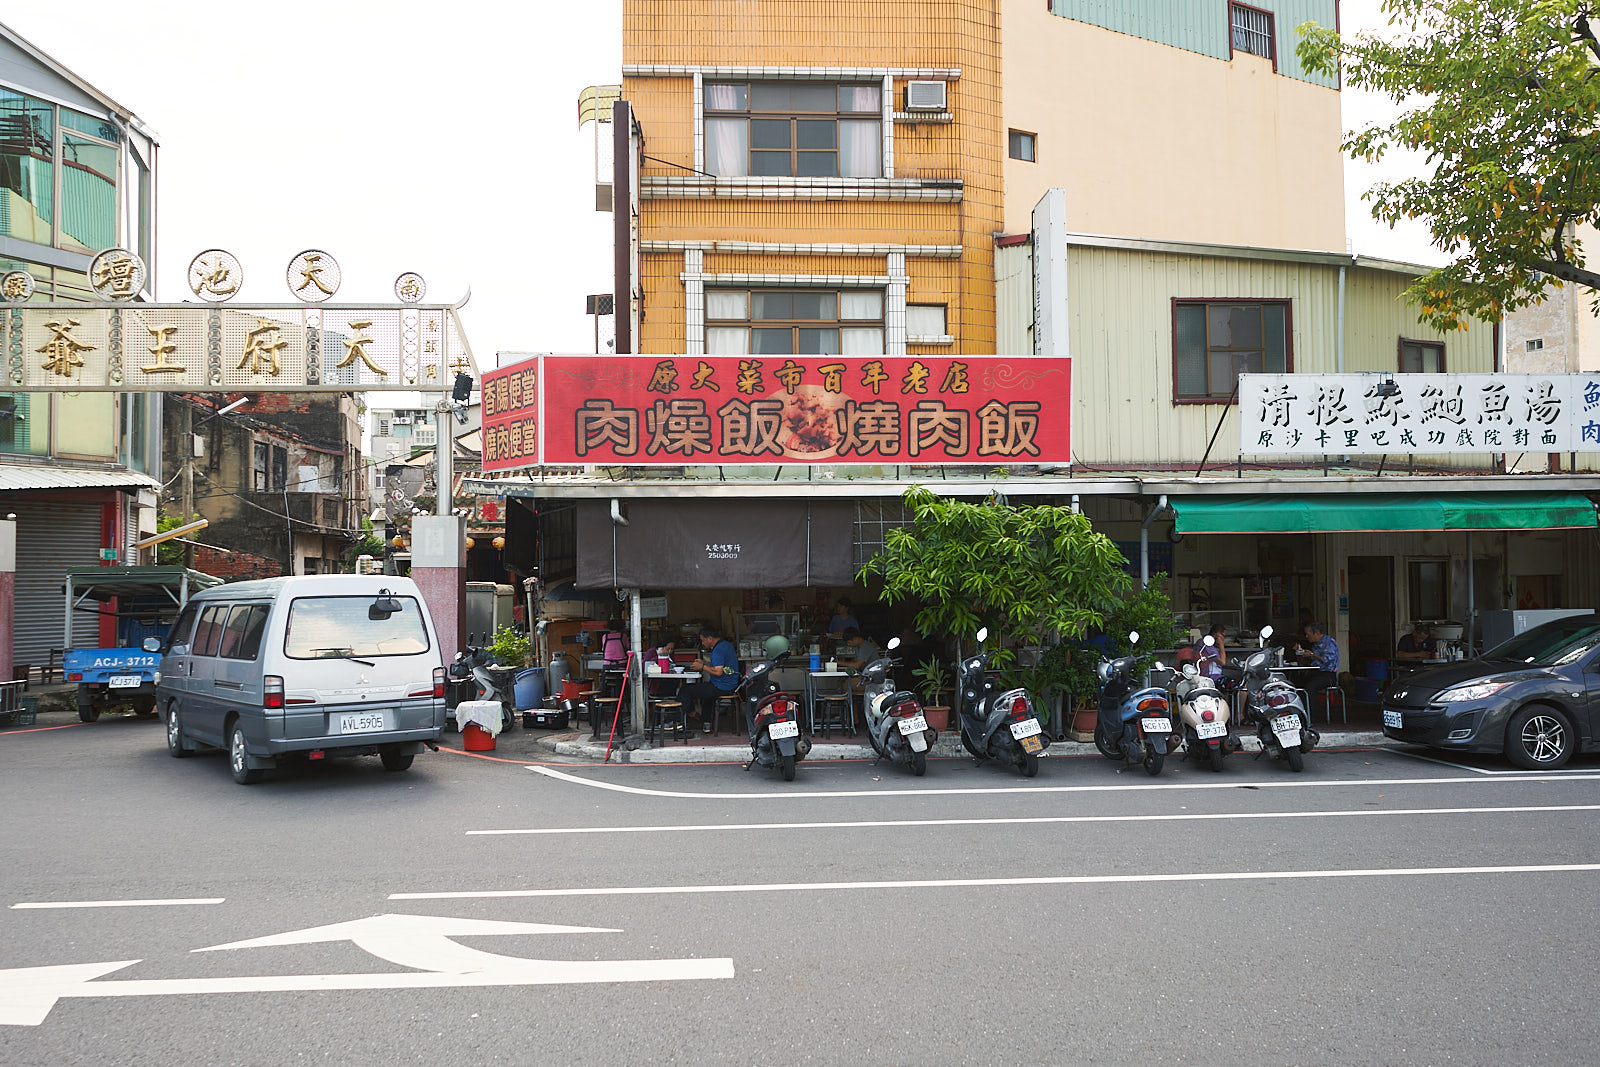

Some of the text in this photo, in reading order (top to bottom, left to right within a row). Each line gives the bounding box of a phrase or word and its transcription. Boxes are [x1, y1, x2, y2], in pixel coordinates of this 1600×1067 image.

[484, 367, 535, 416] 香腸便當
[646, 358, 971, 395] 原大菜市百年老店
[484, 417, 536, 462] 燒肉便當
[574, 398, 1042, 457] 肉燥飯 燒肉飯
[1257, 427, 1557, 447] 原沙卡里吧成功戲院對面
